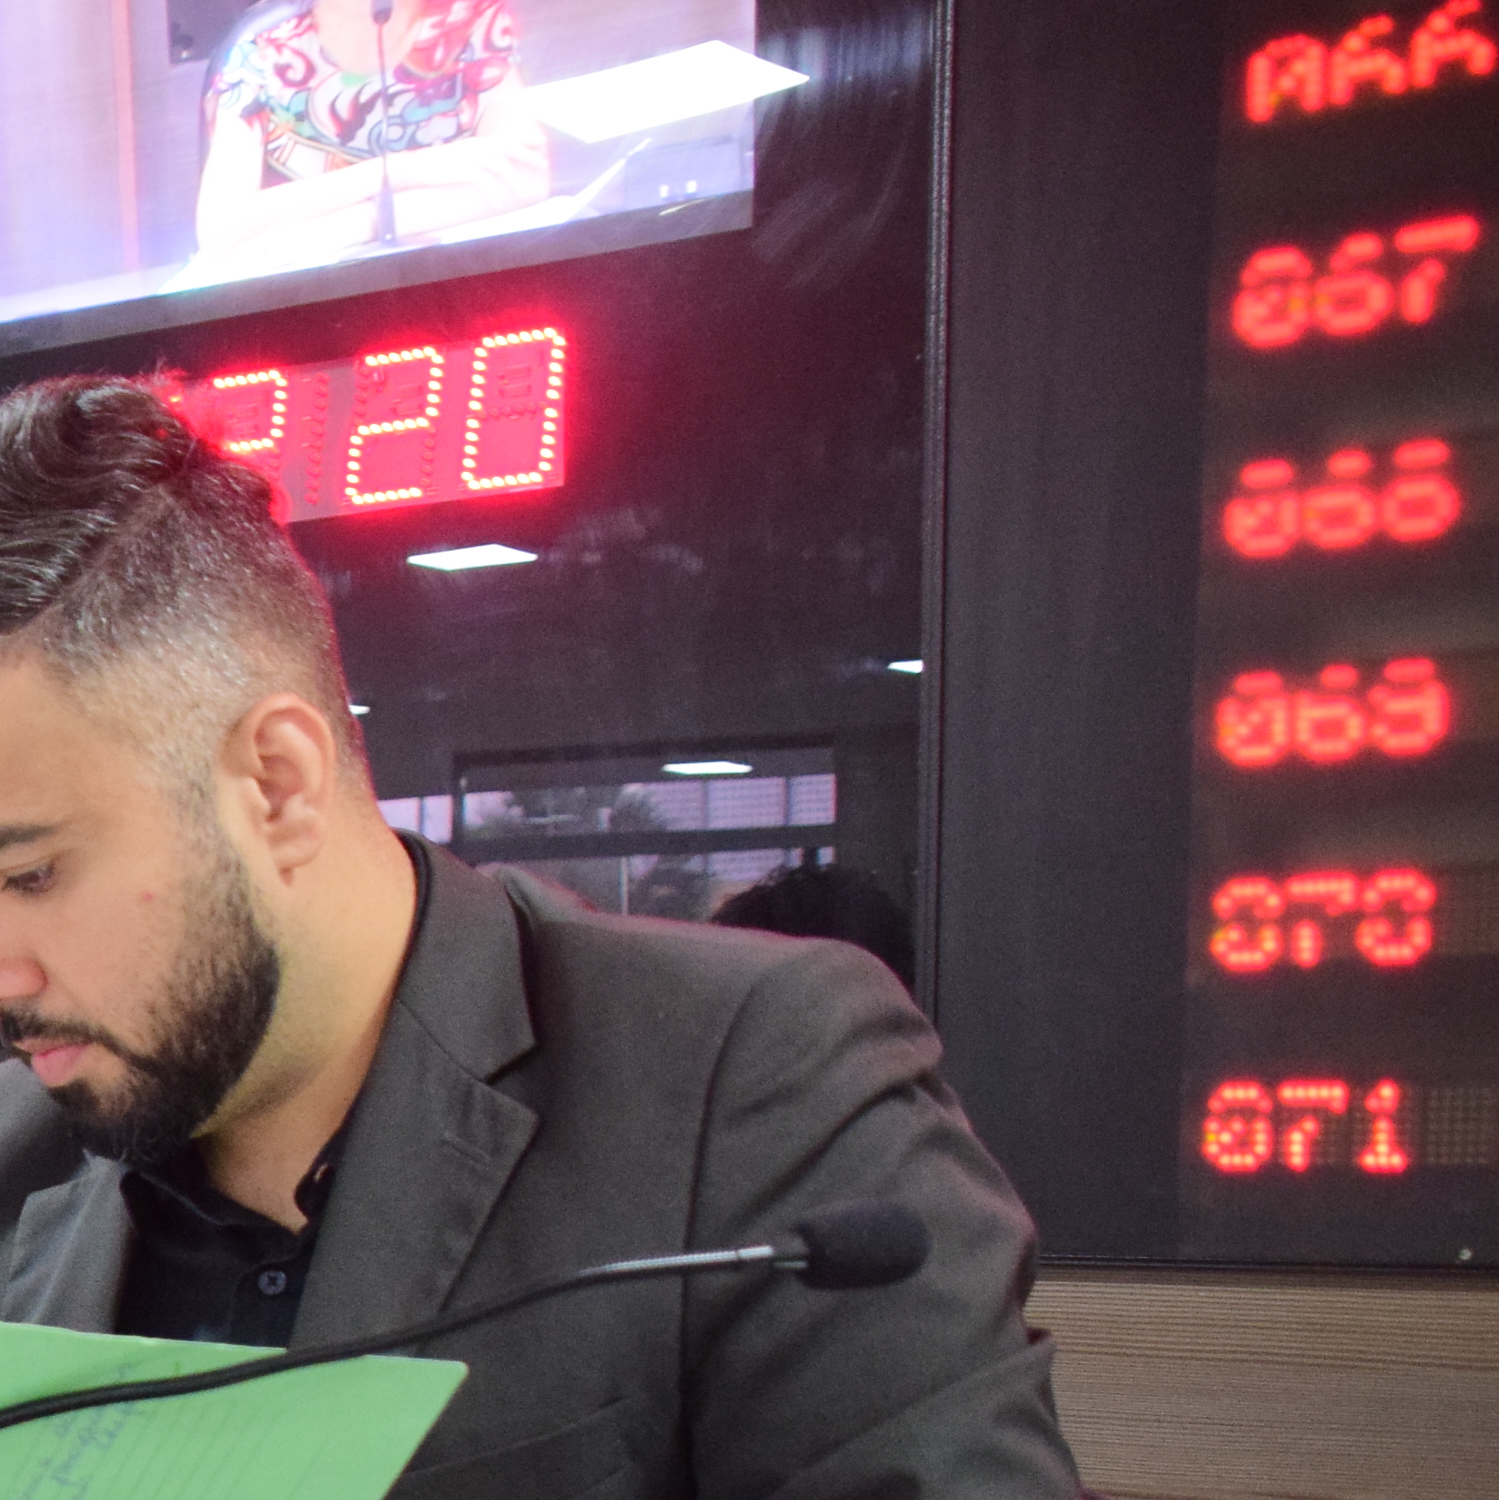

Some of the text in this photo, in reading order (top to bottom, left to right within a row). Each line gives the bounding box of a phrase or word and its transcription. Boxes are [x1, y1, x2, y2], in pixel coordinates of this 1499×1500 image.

[345, 325, 566, 506] 20
[1209, 868, 1437, 973] 070
[1202, 1077, 1408, 1174] 071
